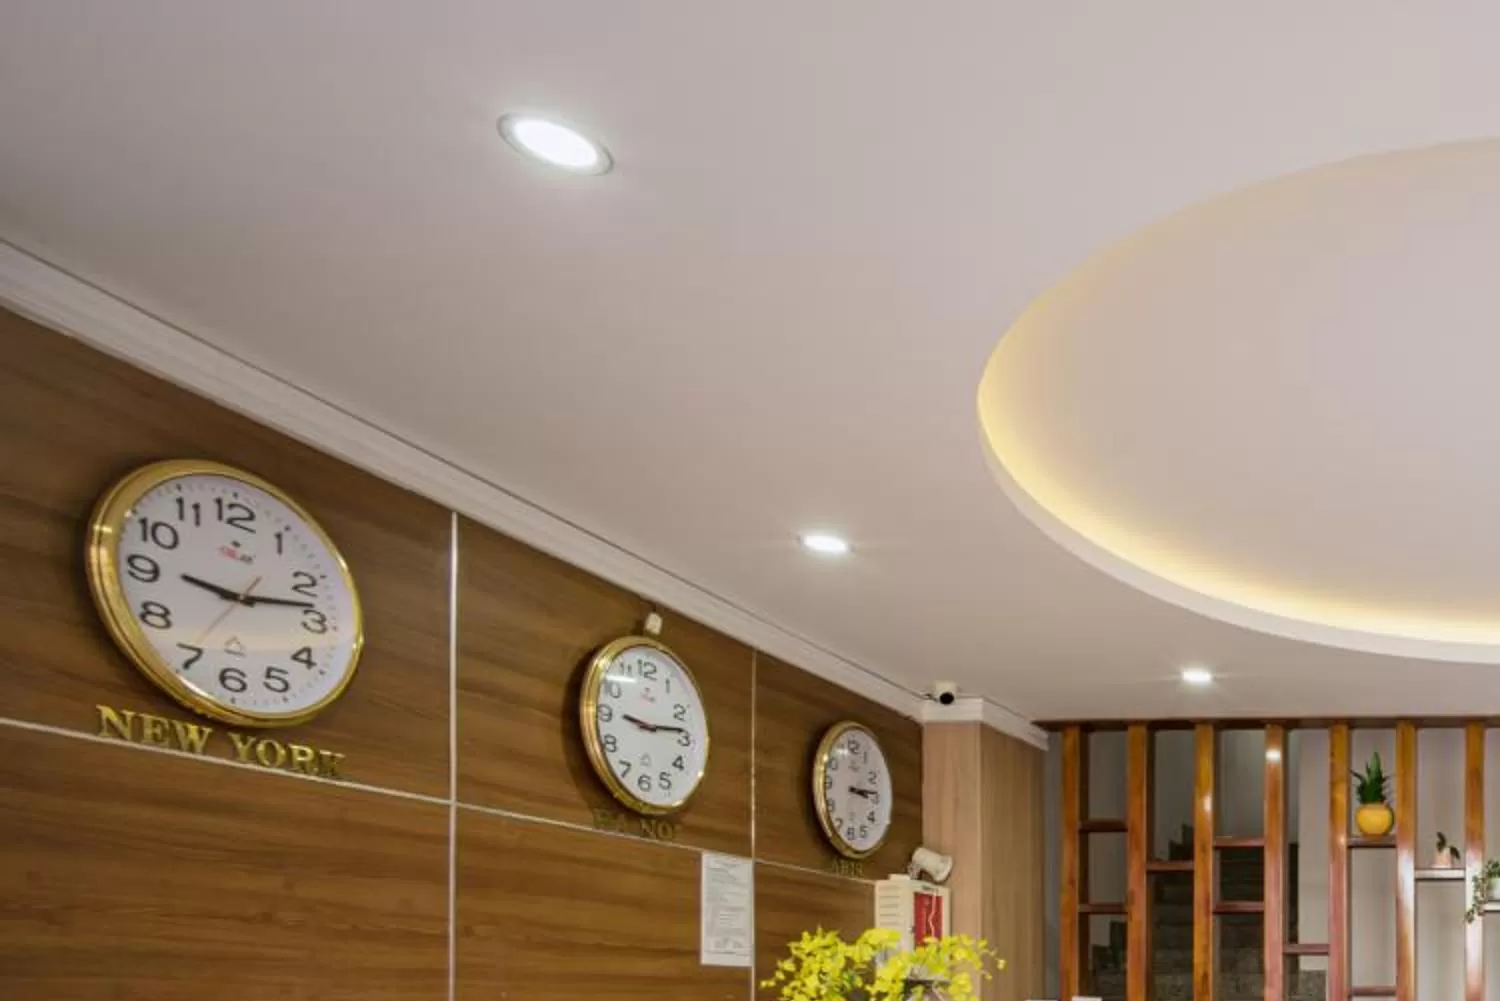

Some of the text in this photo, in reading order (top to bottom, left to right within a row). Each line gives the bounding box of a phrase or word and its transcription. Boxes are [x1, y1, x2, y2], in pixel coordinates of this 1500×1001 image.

[176, 497, 201, 526] 11
[214, 497, 256, 533] 12
[139, 517, 180, 550] 10
[274, 532, 284, 555] 1
[127, 554, 161, 583] 9
[291, 571, 318, 597] 2
[140, 601, 172, 629] 8
[302, 608, 328, 634] 3
[177, 643, 204, 670] 7
[291, 646, 318, 669] 4
[218, 667, 248, 693] 6
[264, 666, 290, 693] 5
[637, 659, 657, 681] 12
[664, 678, 671, 694] 1
[597, 704, 613, 722] 9
[673, 703, 687, 721] 2
[96, 705, 346, 776] NEW YORK
[603, 734, 617, 753] 8
[677, 729, 690, 748] 3
[618, 760, 632, 778] 7
[672, 755, 685, 772] 4
[637, 774, 652, 792] 6
[658, 771, 673, 790] 5
[868, 771, 877, 784] 2
[866, 811, 876, 823] 4
[858, 826, 868, 838] 5
